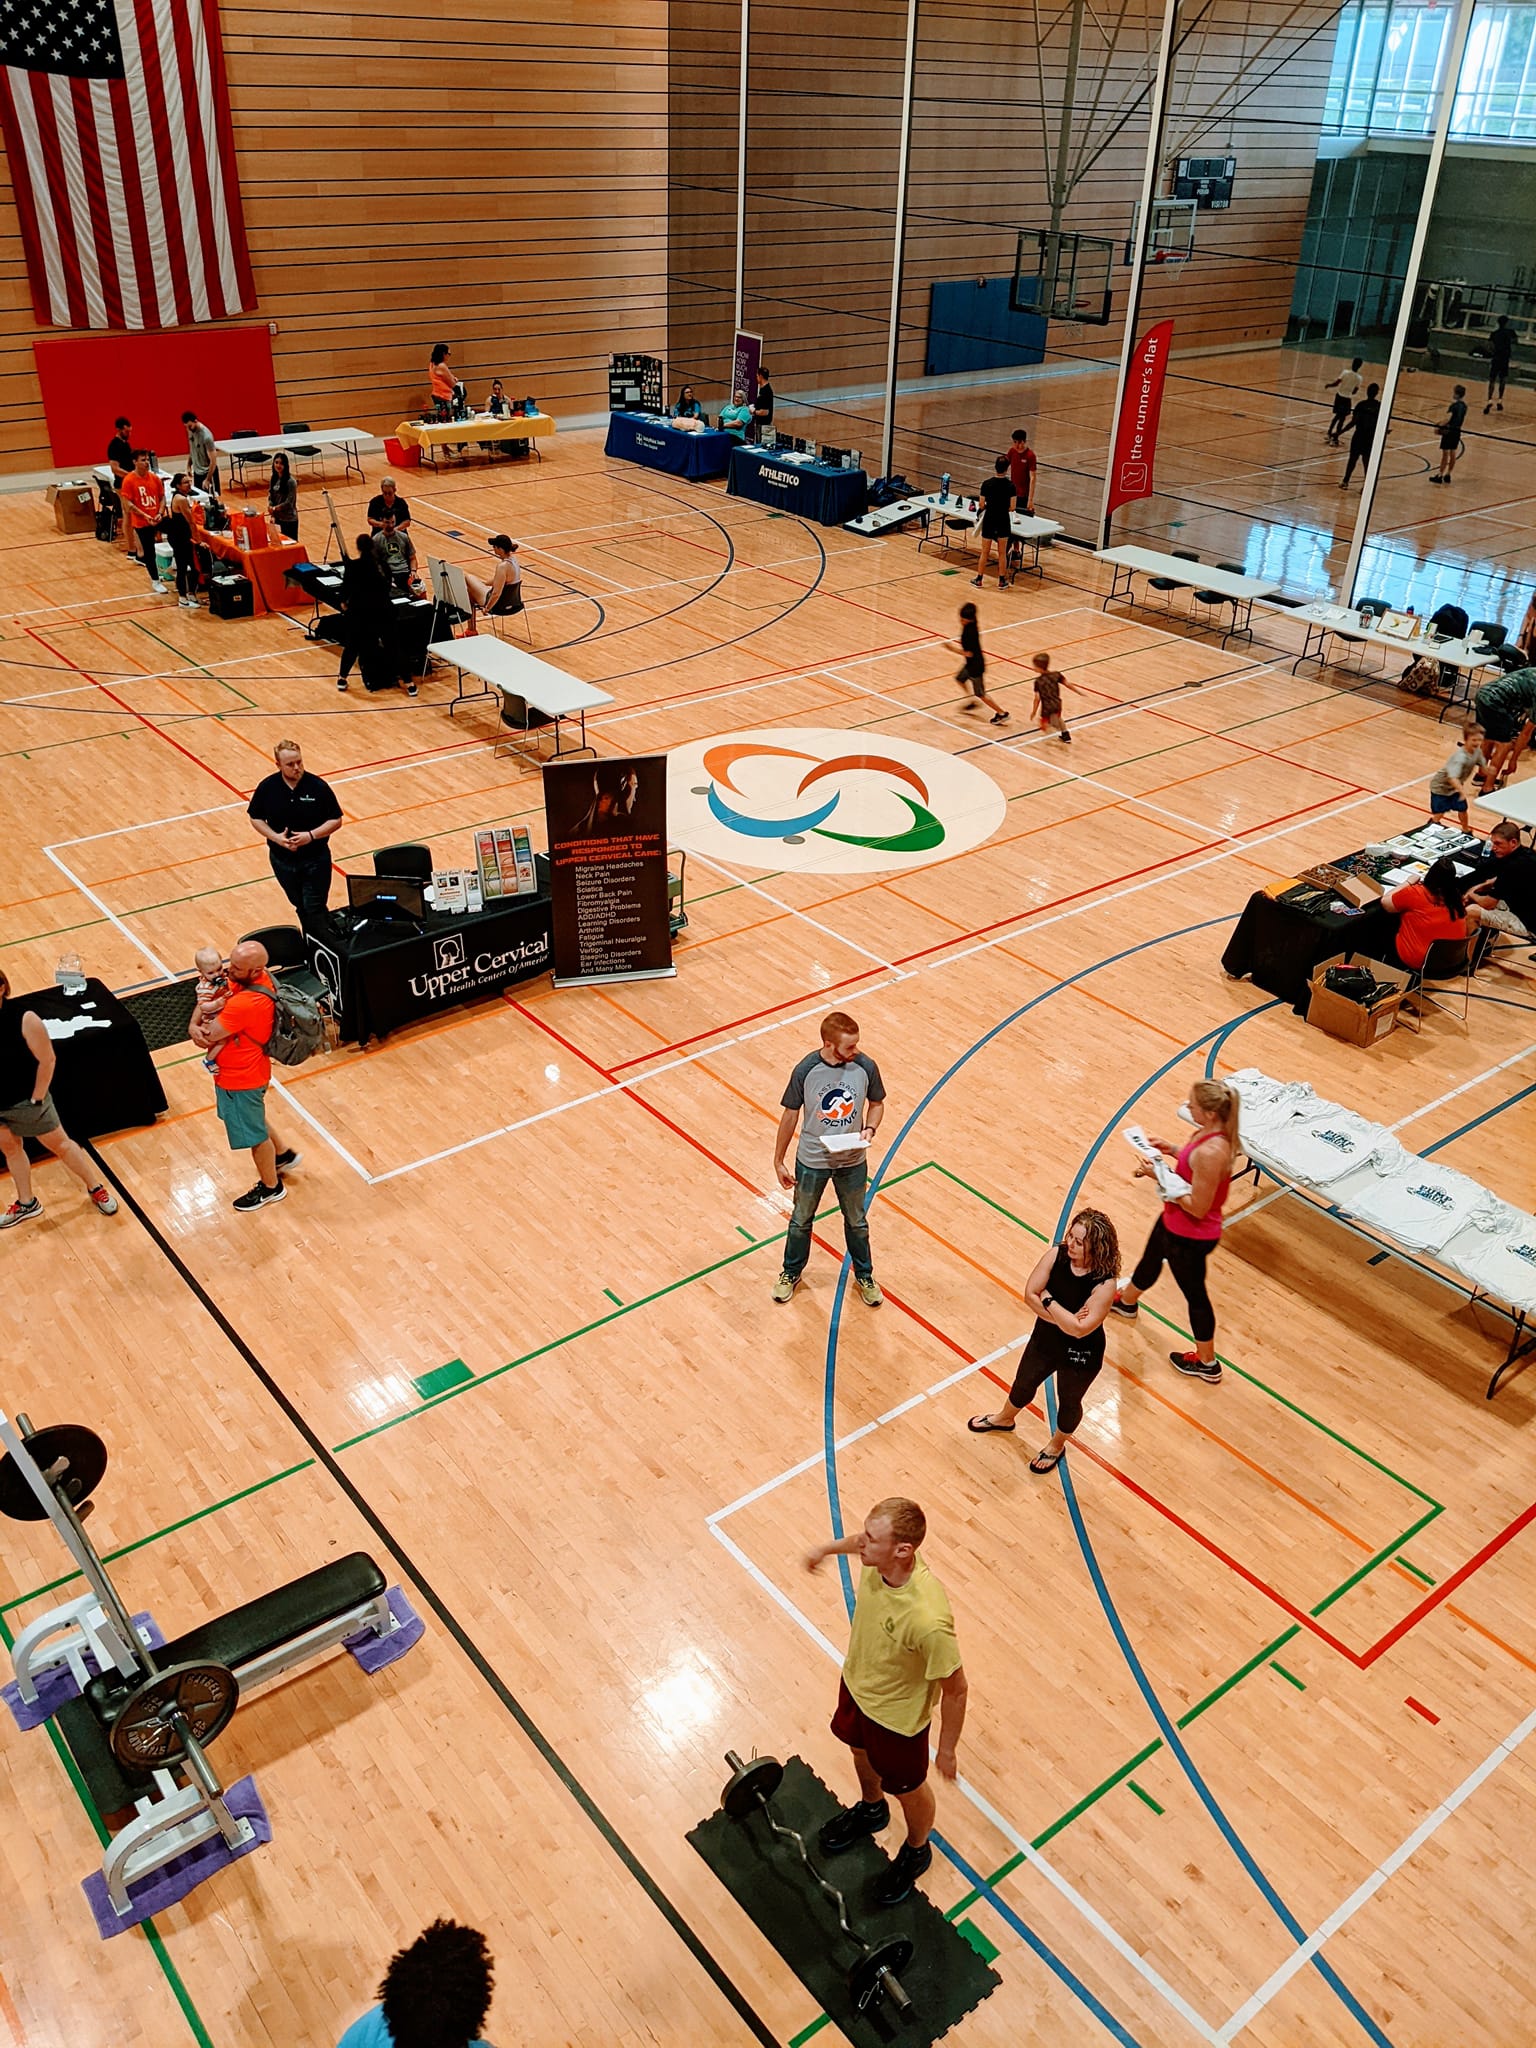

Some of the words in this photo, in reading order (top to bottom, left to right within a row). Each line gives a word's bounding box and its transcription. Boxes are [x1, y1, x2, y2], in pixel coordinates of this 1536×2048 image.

[1144, 337, 1158, 364] flat
[1136, 367, 1153, 430] runner's
[1130, 434, 1143, 460] the
[758, 464, 799, 486] ATHLETICO
[554, 838, 608, 849] CONDITIONS
[572, 844, 628, 854] RESPONDED
[556, 856, 587, 866] UPPER
[589, 852, 632, 861] CERVICAL
[575, 865, 604, 873] Migraine
[606, 861, 644, 870] Headaches
[603, 876, 636, 884] Disorders
[577, 898, 620, 907] Fibromyalgia
[577, 906, 608, 914] Digestive
[578, 911, 616, 920] ADD/ADHD
[580, 938, 614, 947] Trigeminal
[615, 936, 647, 944] Neuralgia
[610, 950, 642, 958] Disorders
[408, 965, 471, 1000] Upper
[474, 931, 549, 973] Cervical
[594, 958, 625, 966] Infections
[449, 979, 476, 994] Health
[478, 970, 507, 984] Centers
[508, 963, 519, 974] Of
[1419, 1184, 1452, 1204] PUMP
